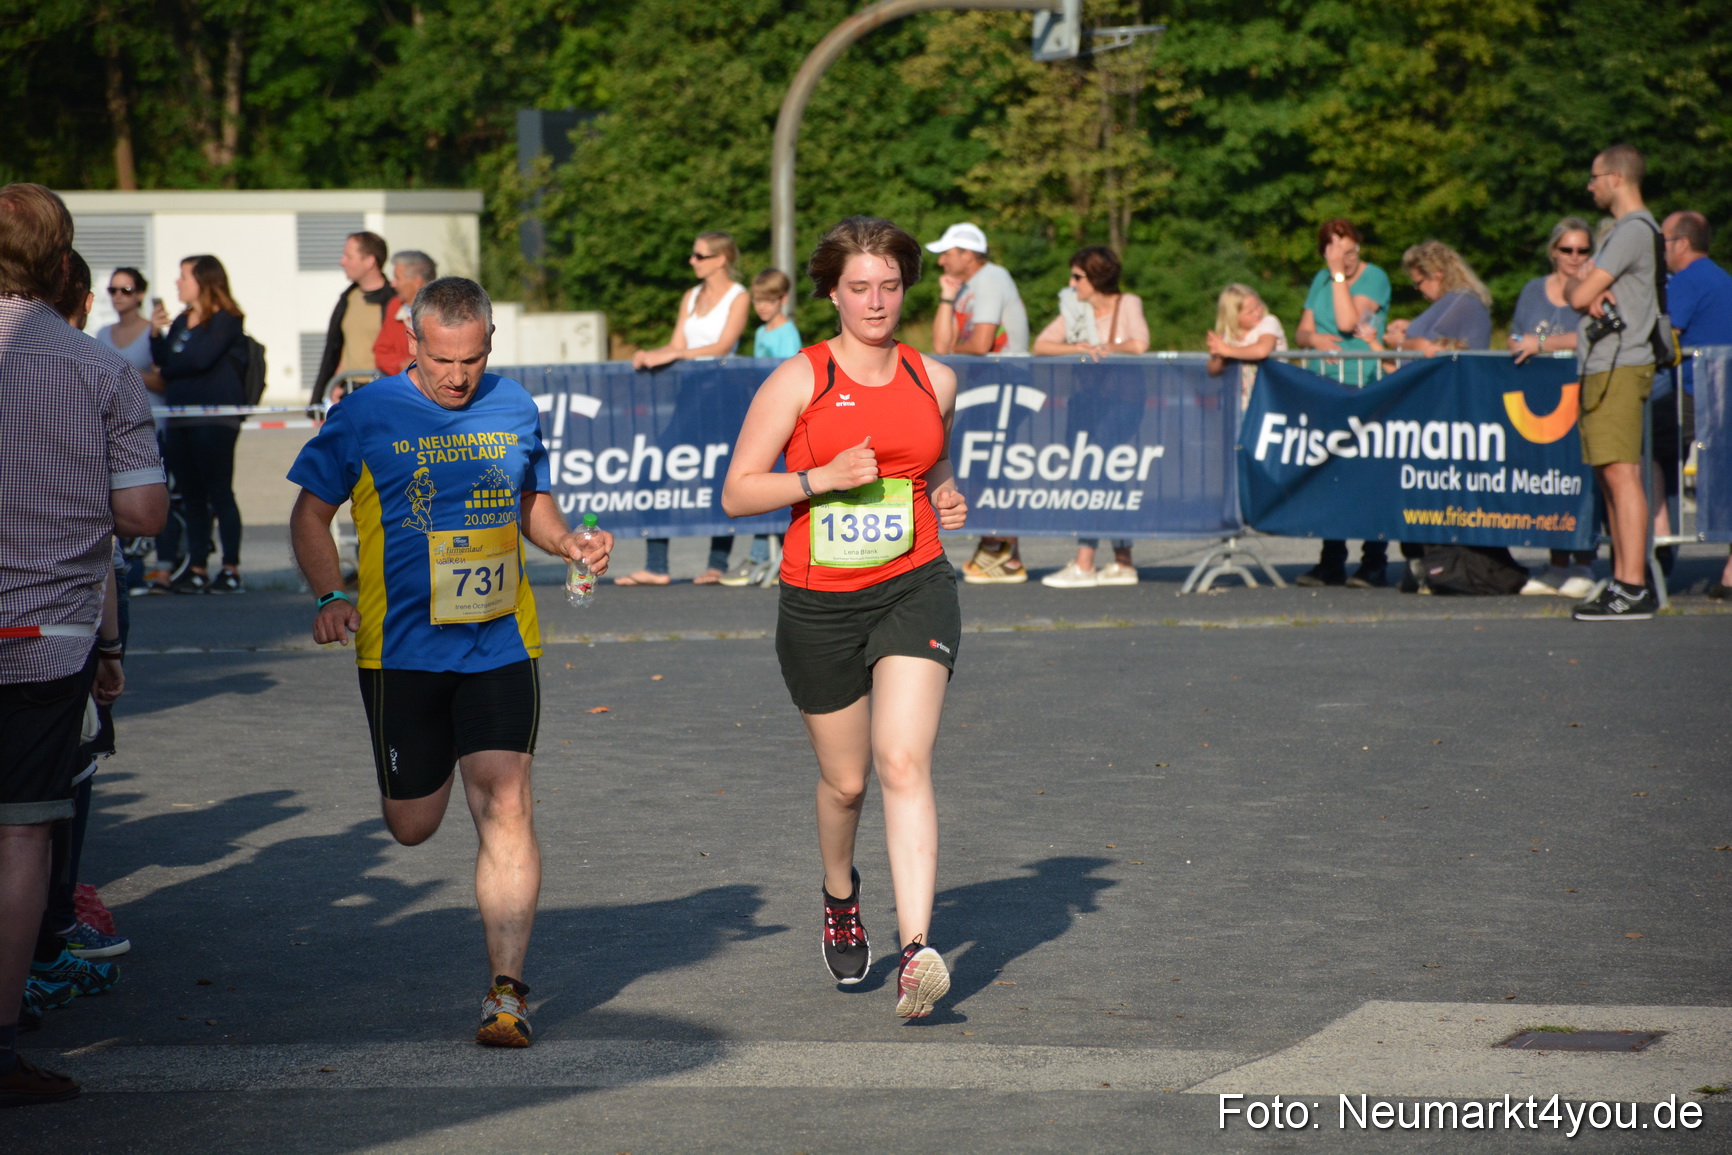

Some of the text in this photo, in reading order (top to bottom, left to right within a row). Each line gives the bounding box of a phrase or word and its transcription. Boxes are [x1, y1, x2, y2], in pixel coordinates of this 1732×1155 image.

[392, 432, 519, 454] 10. NEUMARKTER
[1254, 412, 1507, 466] Frischmann
[416, 446, 507, 465] STADTLAUF
[542, 434, 729, 485] ischer
[958, 431, 1165, 481] Fischer
[1401, 464, 1582, 496] Druck und Medien
[558, 488, 713, 514] UTOMOBILE
[976, 488, 1143, 511] AUTOMOBILE
[821, 513, 903, 542] 1385
[1403, 505, 1577, 532] www.frischmann-net.de
[452, 563, 505, 597] 731
